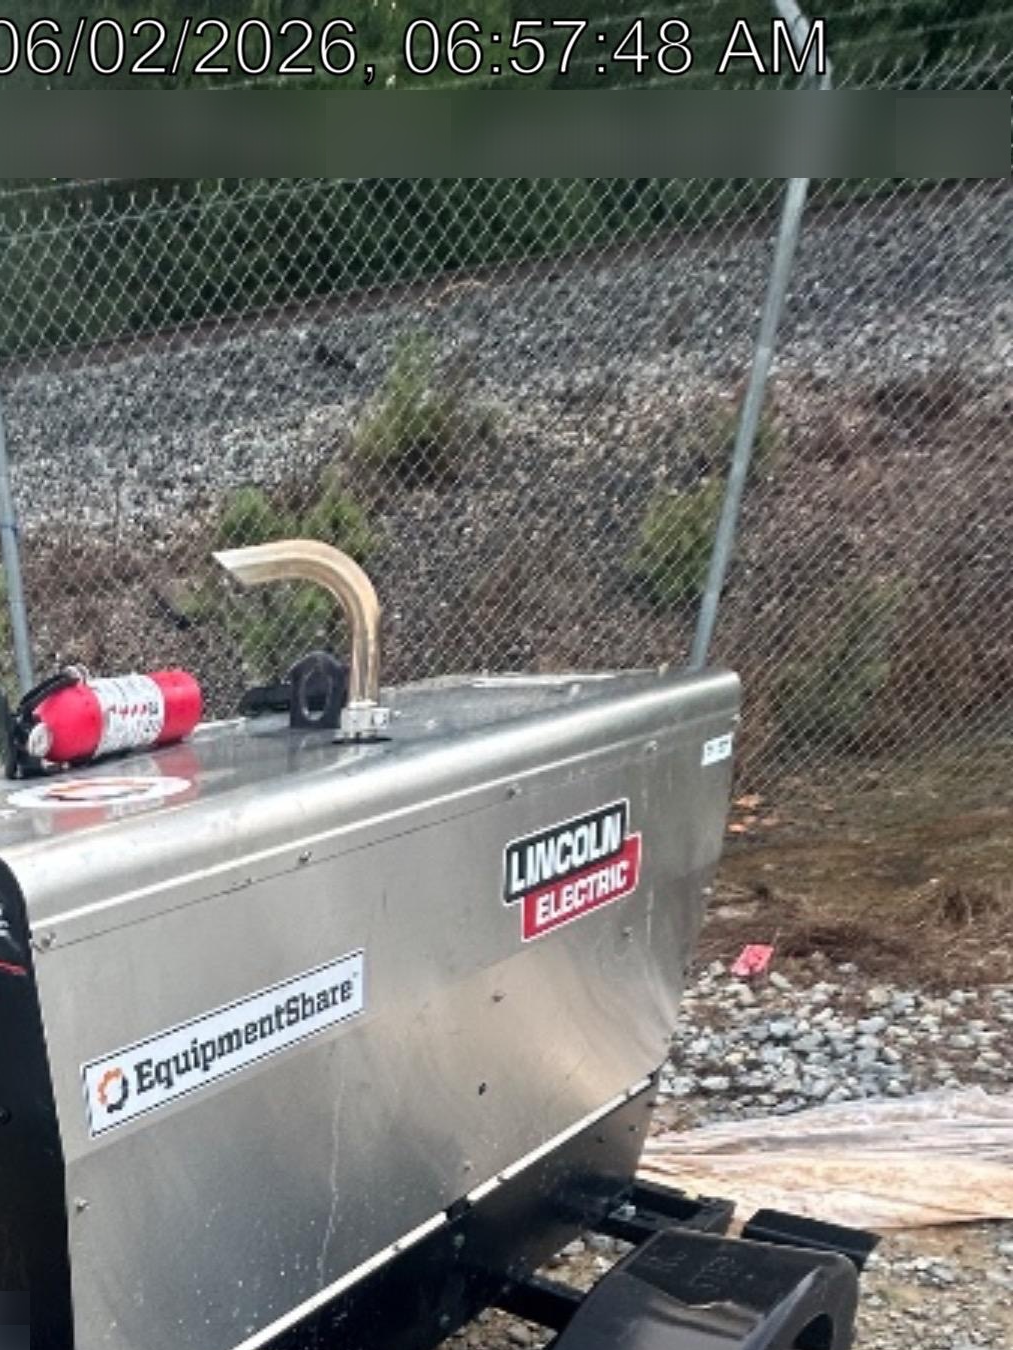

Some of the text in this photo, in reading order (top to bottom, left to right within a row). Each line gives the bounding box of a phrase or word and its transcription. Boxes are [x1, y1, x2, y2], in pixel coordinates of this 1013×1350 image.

[511, 812, 622, 895] LINCOLN
[535, 860, 630, 928] ELECTRIC
[133, 978, 354, 1095] EquipmentShare
